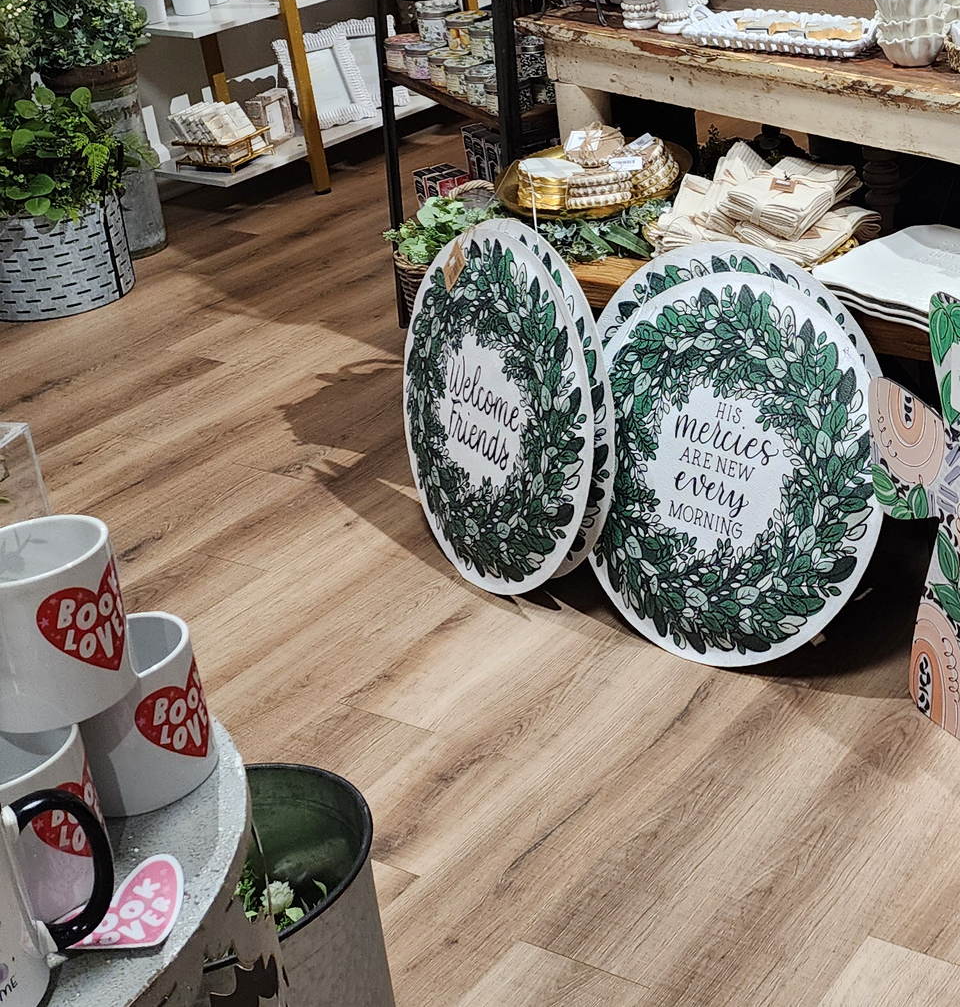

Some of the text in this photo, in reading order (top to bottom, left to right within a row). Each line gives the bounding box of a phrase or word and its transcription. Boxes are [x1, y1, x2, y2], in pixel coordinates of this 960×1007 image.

[447, 356, 519, 432] Welcome
[715, 401, 742, 424] HIS
[448, 397, 510, 470] Friends
[678, 446, 755, 482] ARE NEW
[674, 471, 749, 518] every
[668, 500, 743, 539] MORNING
